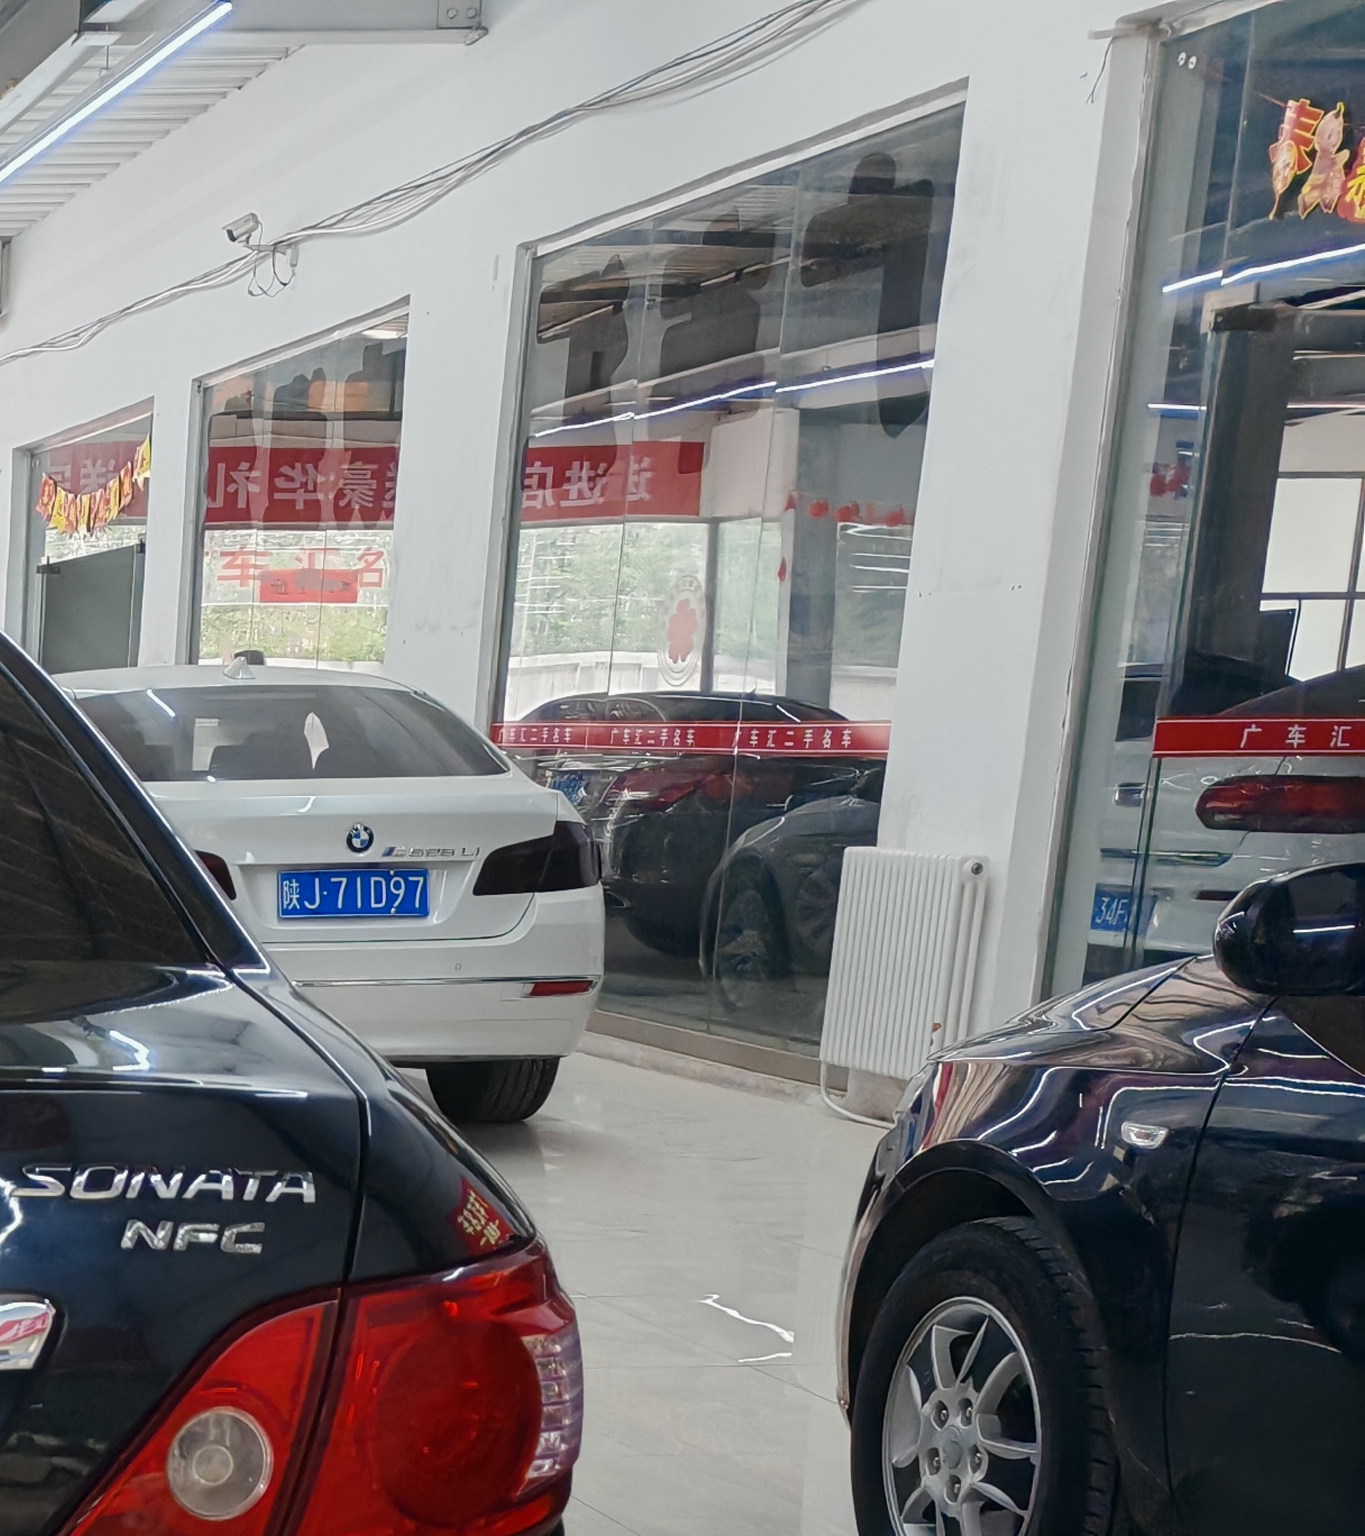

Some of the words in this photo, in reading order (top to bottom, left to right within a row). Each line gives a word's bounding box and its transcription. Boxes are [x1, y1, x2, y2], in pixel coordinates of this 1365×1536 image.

[610, 728, 696, 747] 广车汇二手名车
[731, 728, 853, 749] 广车汇二手名车
[1240, 724, 1352, 748] 广车汇
[10, 1163, 316, 1203] SONATA
[120, 1219, 266, 1254] NFC
